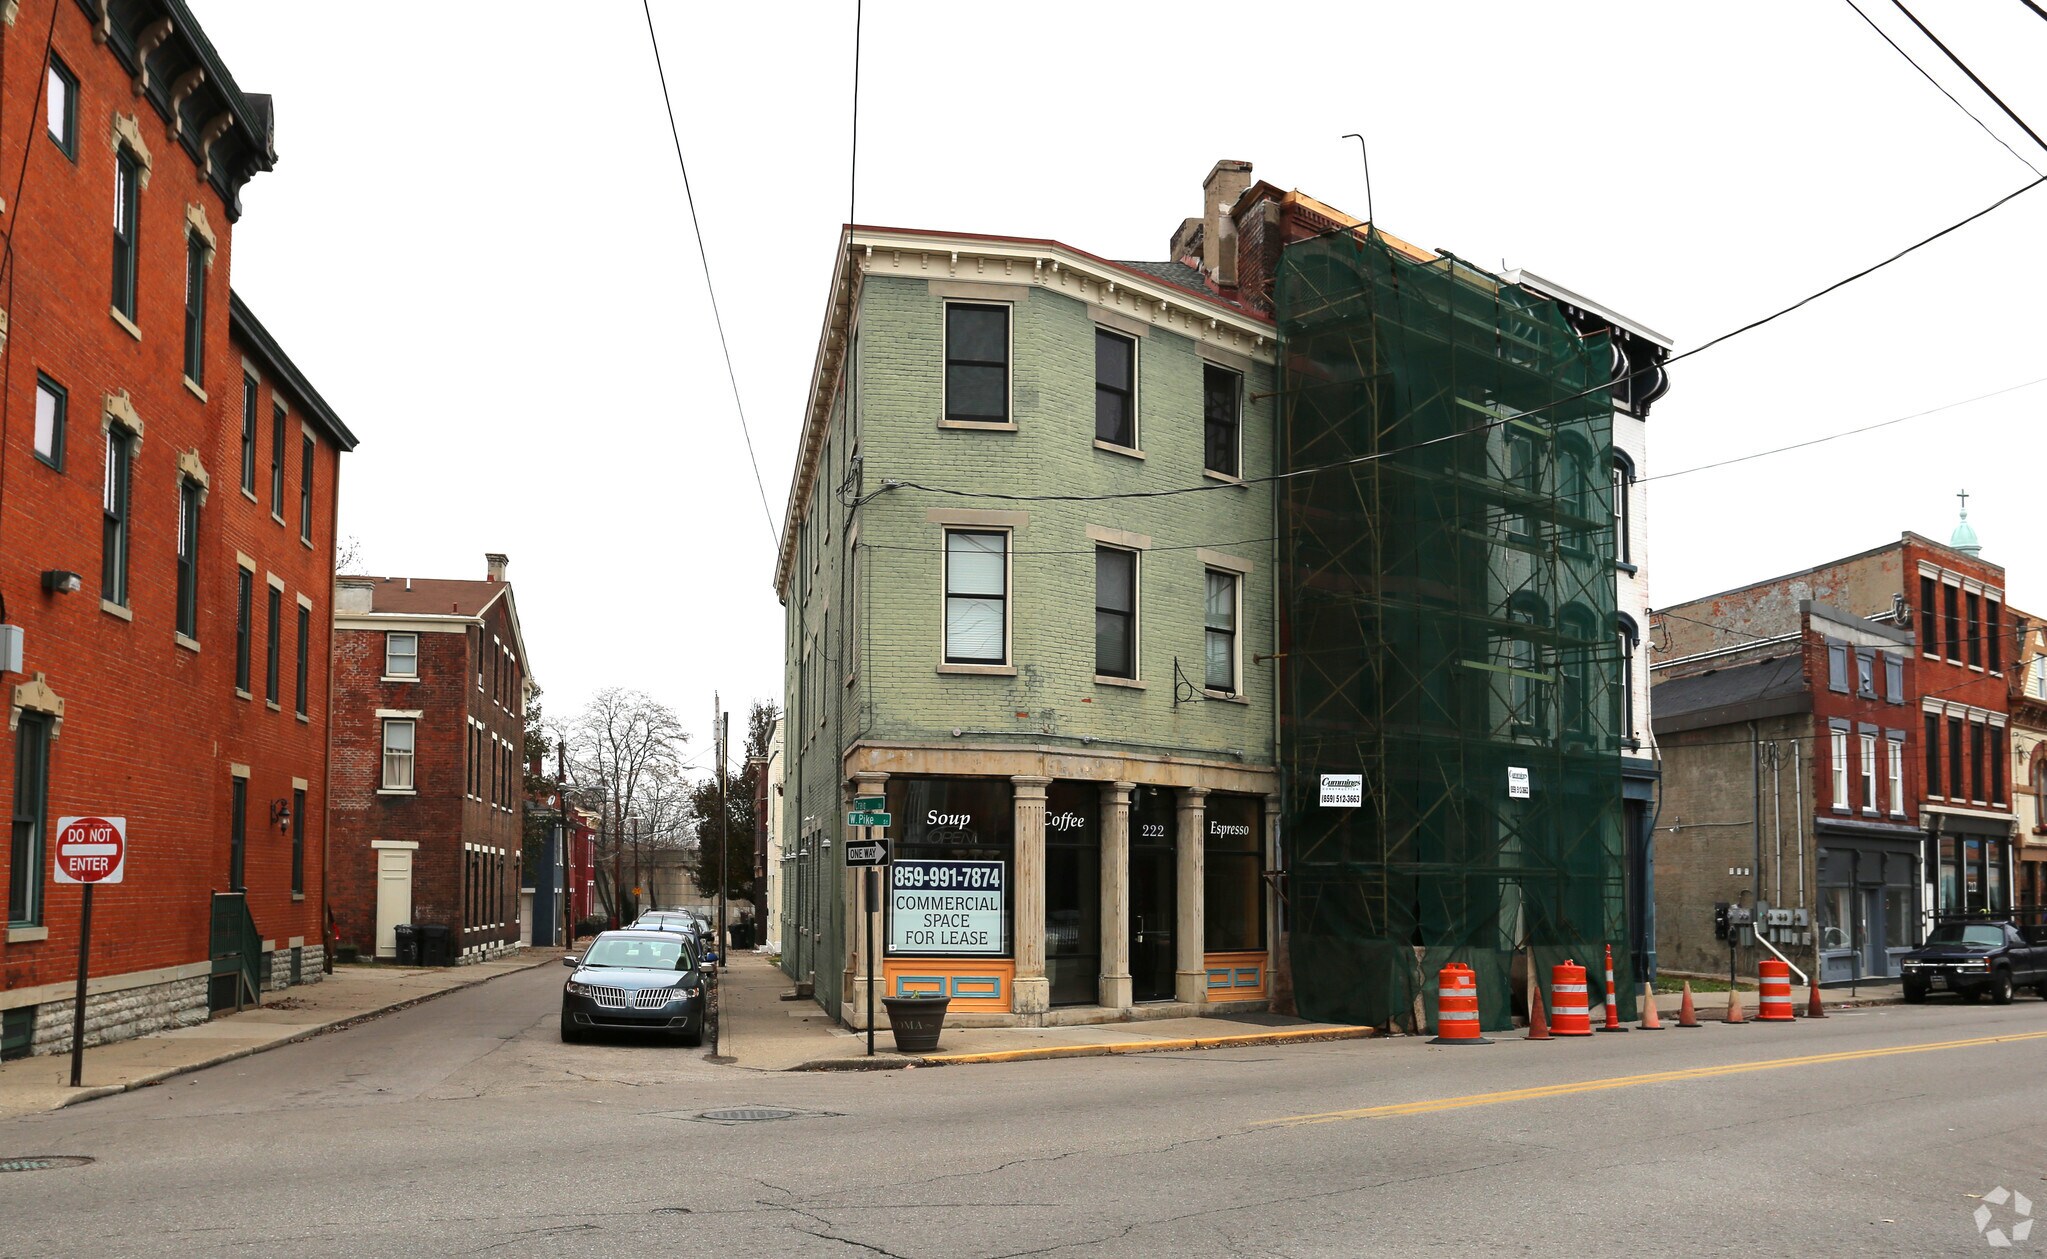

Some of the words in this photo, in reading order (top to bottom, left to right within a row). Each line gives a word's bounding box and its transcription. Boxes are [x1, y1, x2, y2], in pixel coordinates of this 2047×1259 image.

[1322, 777, 1360, 787] Cummings
[1321, 794, 1335, 803] (859)
[1335, 794, 1360, 803] 512-3663
[926, 810, 971, 830] Soup
[1044, 811, 1085, 831] Coffee
[68, 828, 85, 843] DO
[89, 828, 113, 843] NOT
[1142, 824, 1164, 837] 222
[1210, 820, 1250, 839] Espresso
[850, 849, 862, 859] ONE
[863, 848, 877, 858] WAY
[69, 857, 109, 871] ENTER
[894, 866, 1000, 888] 859-991-7874
[896, 896, 998, 911] COMMERCIAL
[923, 913, 970, 928] SPACE
[905, 930, 935, 945] FOR
[941, 931, 988, 945] LEASE
